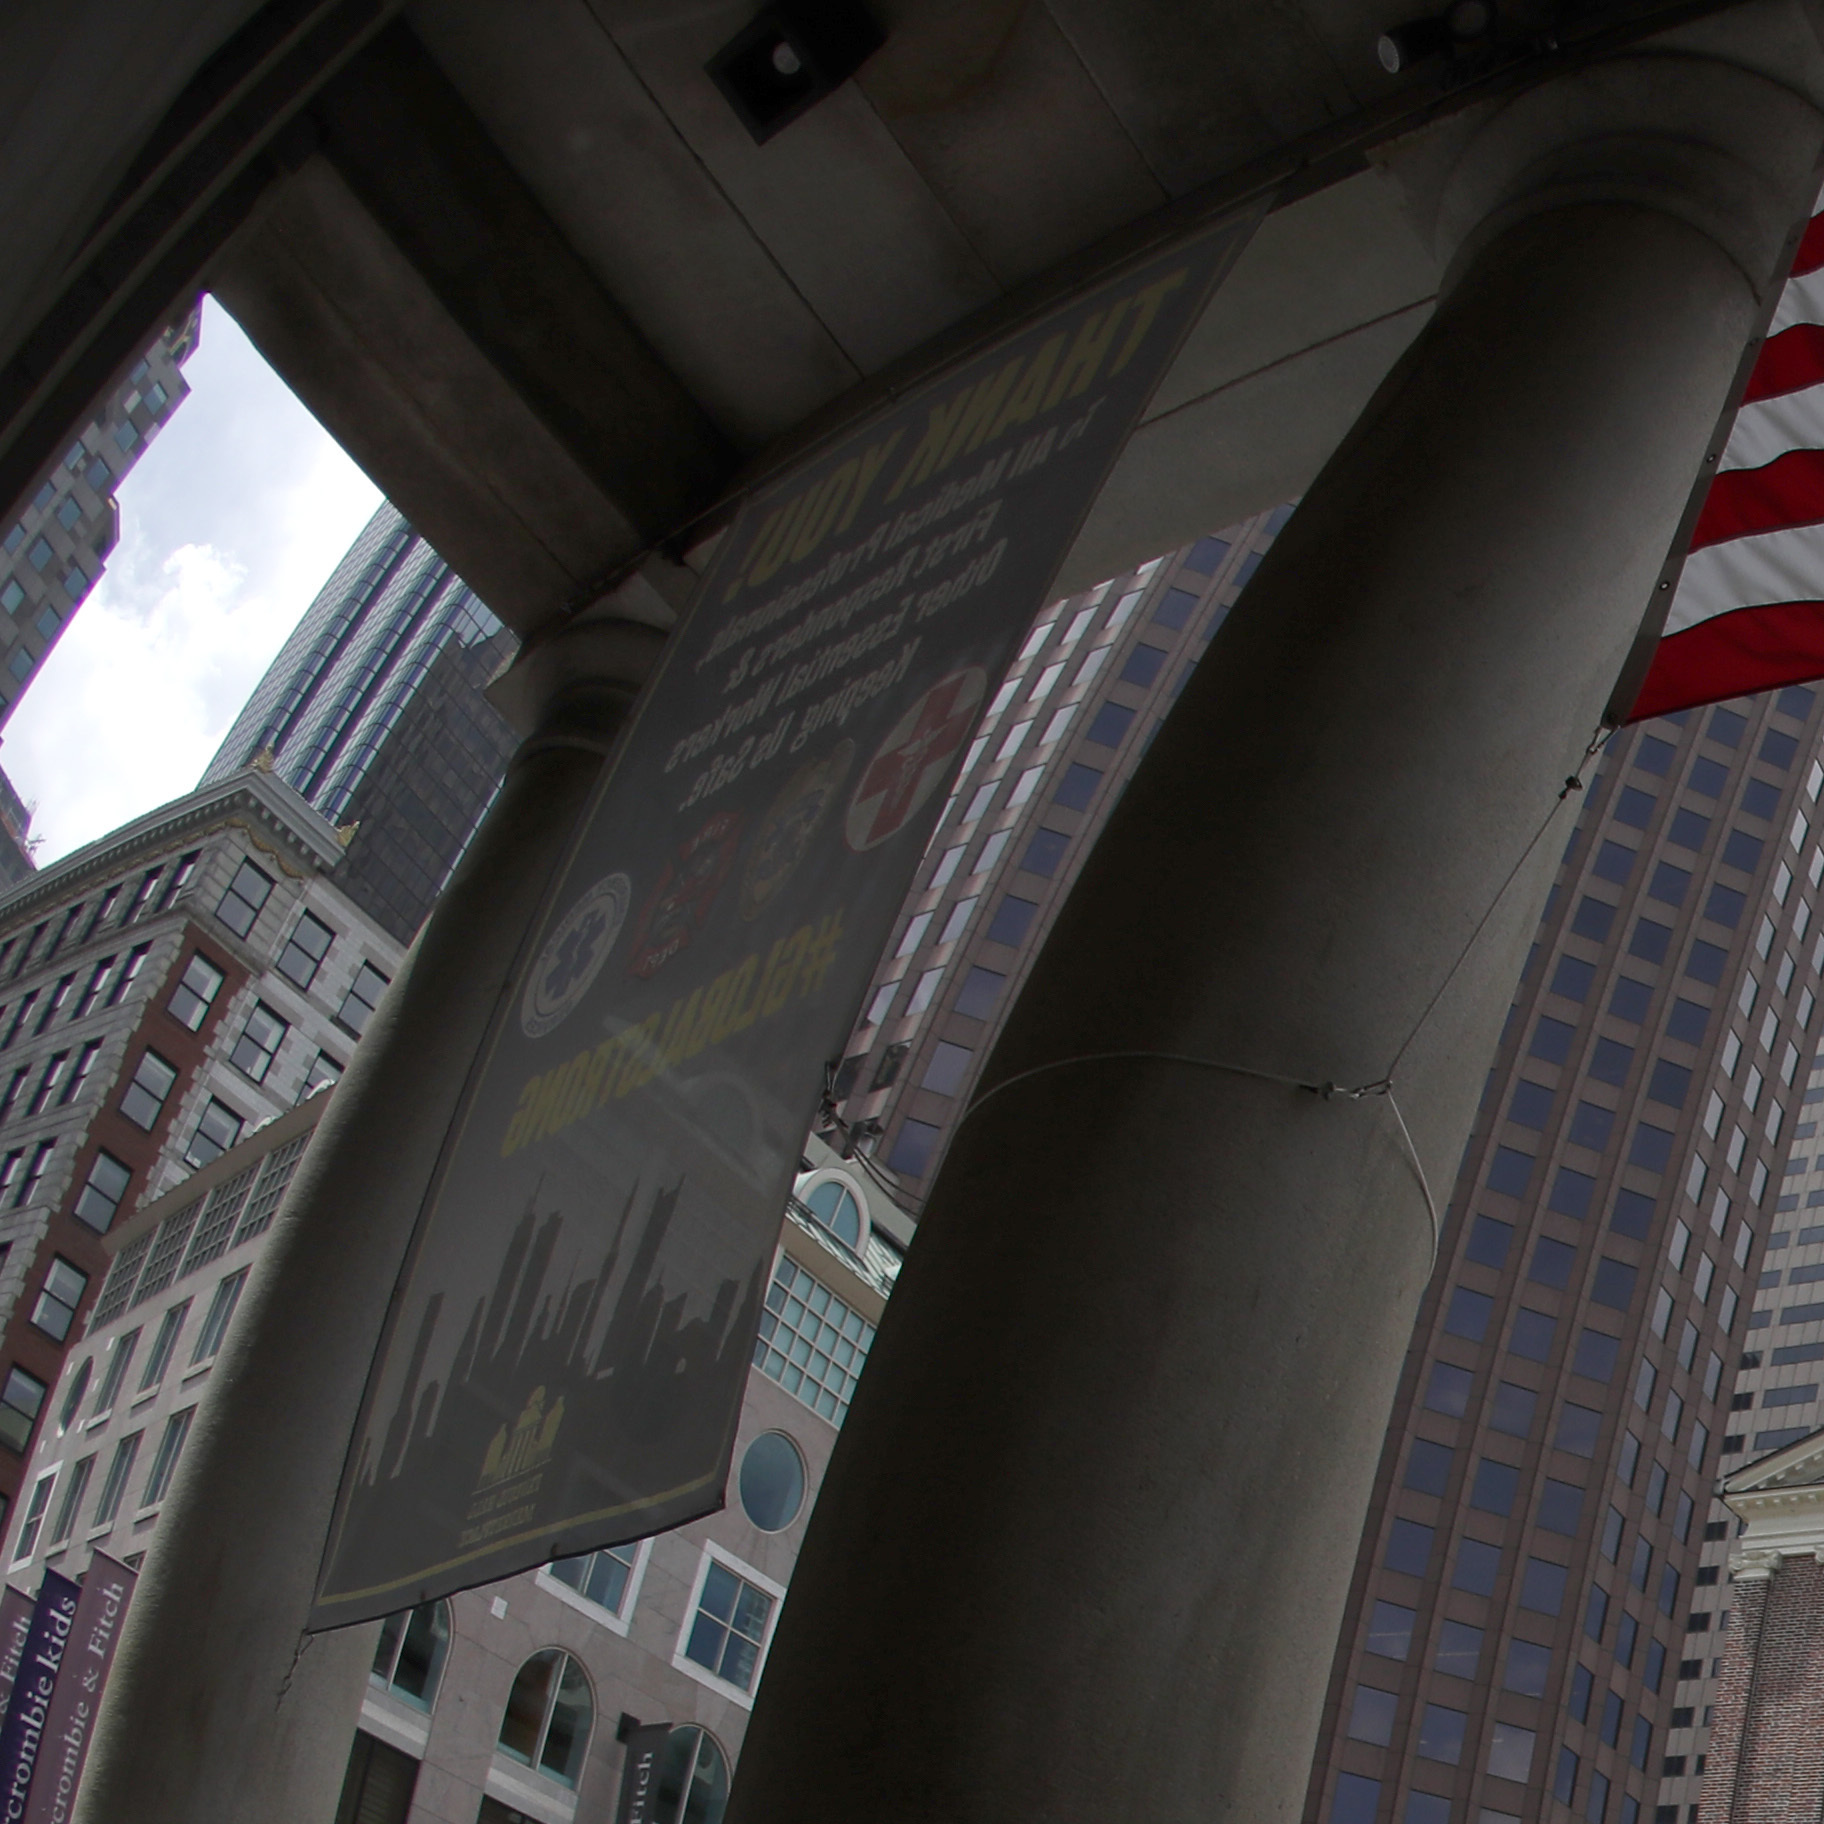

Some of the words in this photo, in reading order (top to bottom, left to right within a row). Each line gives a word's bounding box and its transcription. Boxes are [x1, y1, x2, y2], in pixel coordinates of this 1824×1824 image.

[35, 1596, 77, 1674] kids
[87, 1581, 125, 1658] Fitch
[82, 1667, 101, 1693] &
